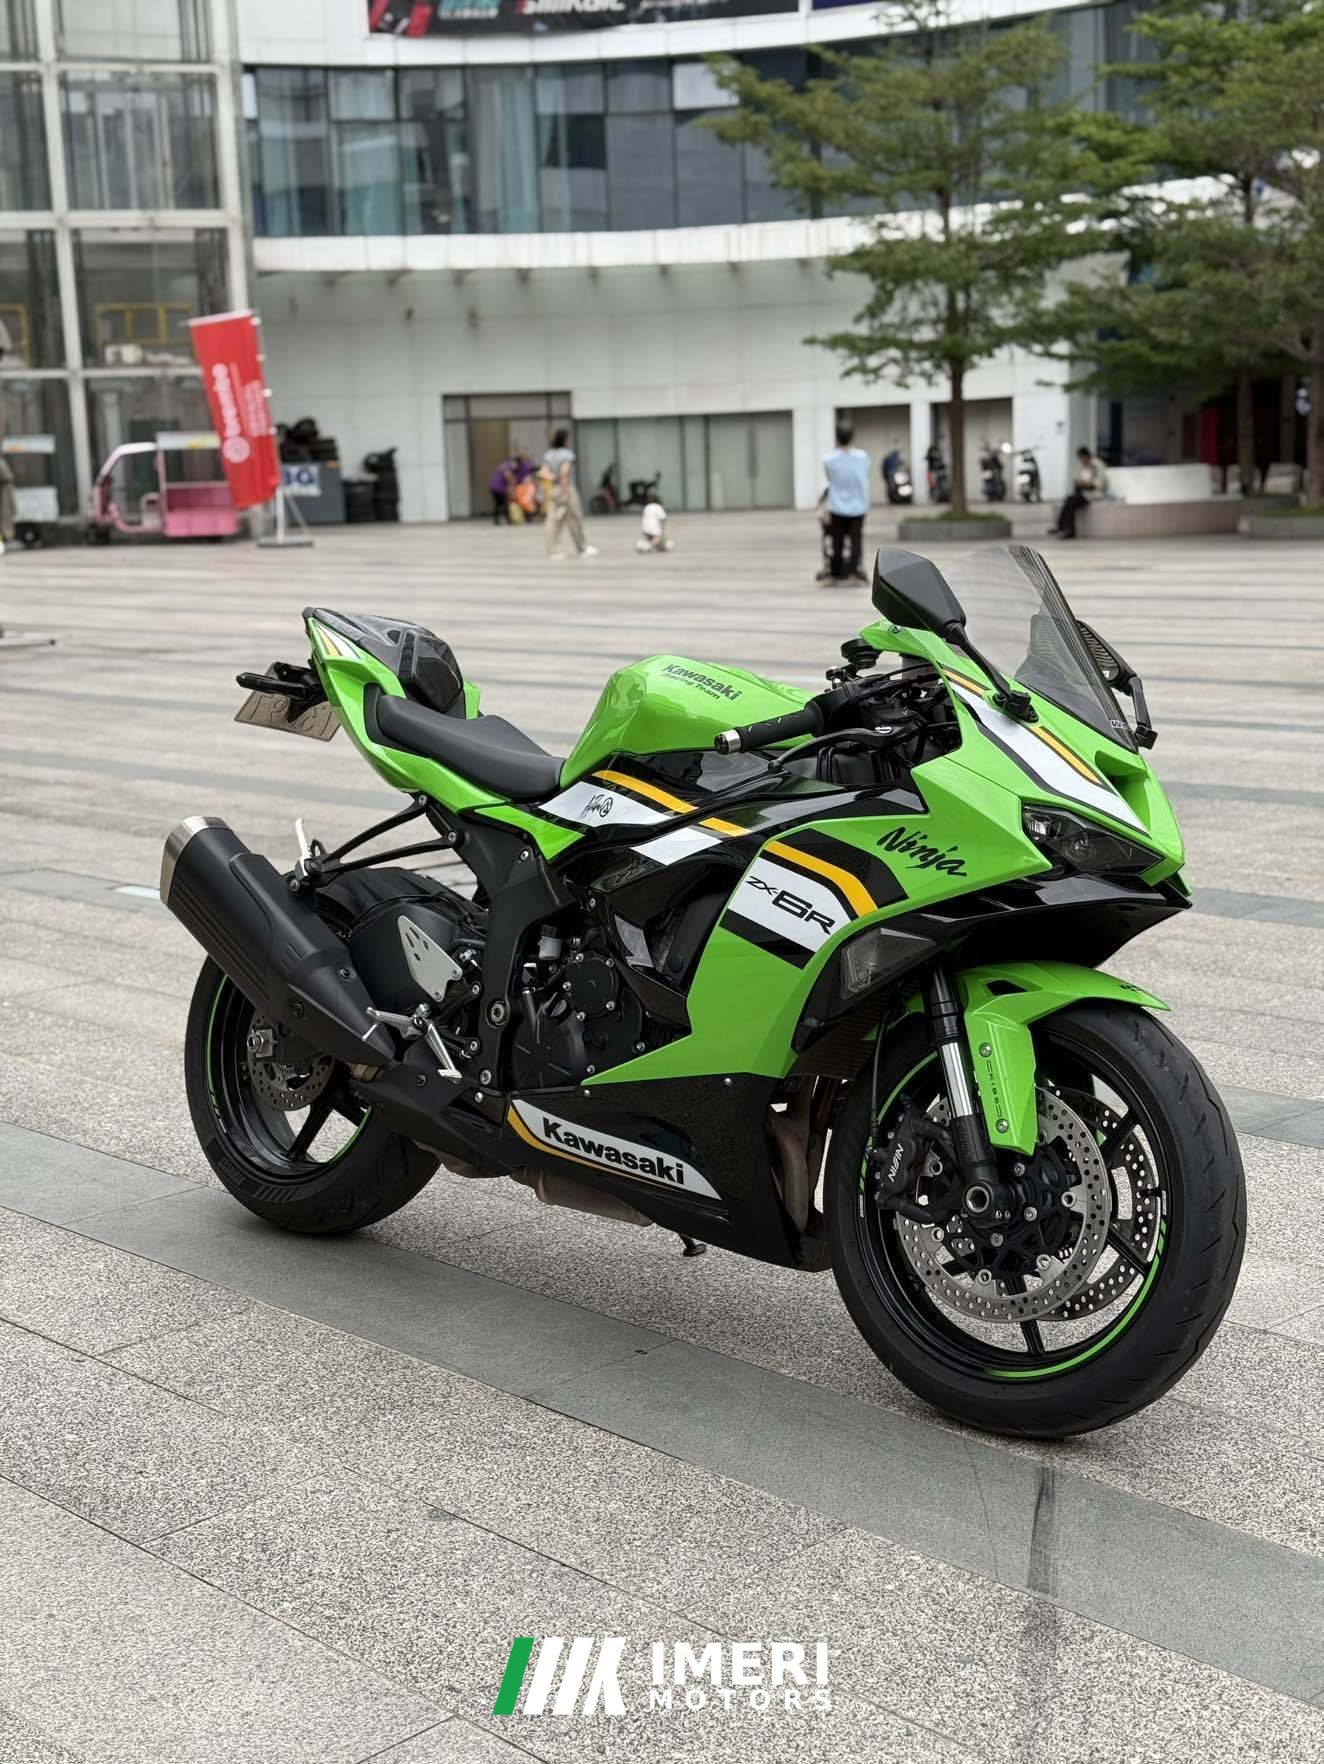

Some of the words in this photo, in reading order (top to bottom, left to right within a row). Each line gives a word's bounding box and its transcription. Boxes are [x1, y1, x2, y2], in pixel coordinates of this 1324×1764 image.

[661, 664, 743, 701] Kawasaki
[695, 683, 721, 700] Team
[876, 826, 968, 877] Ninja
[745, 875, 836, 935] ZX-6R
[542, 1116, 685, 1185] Kawasaki
